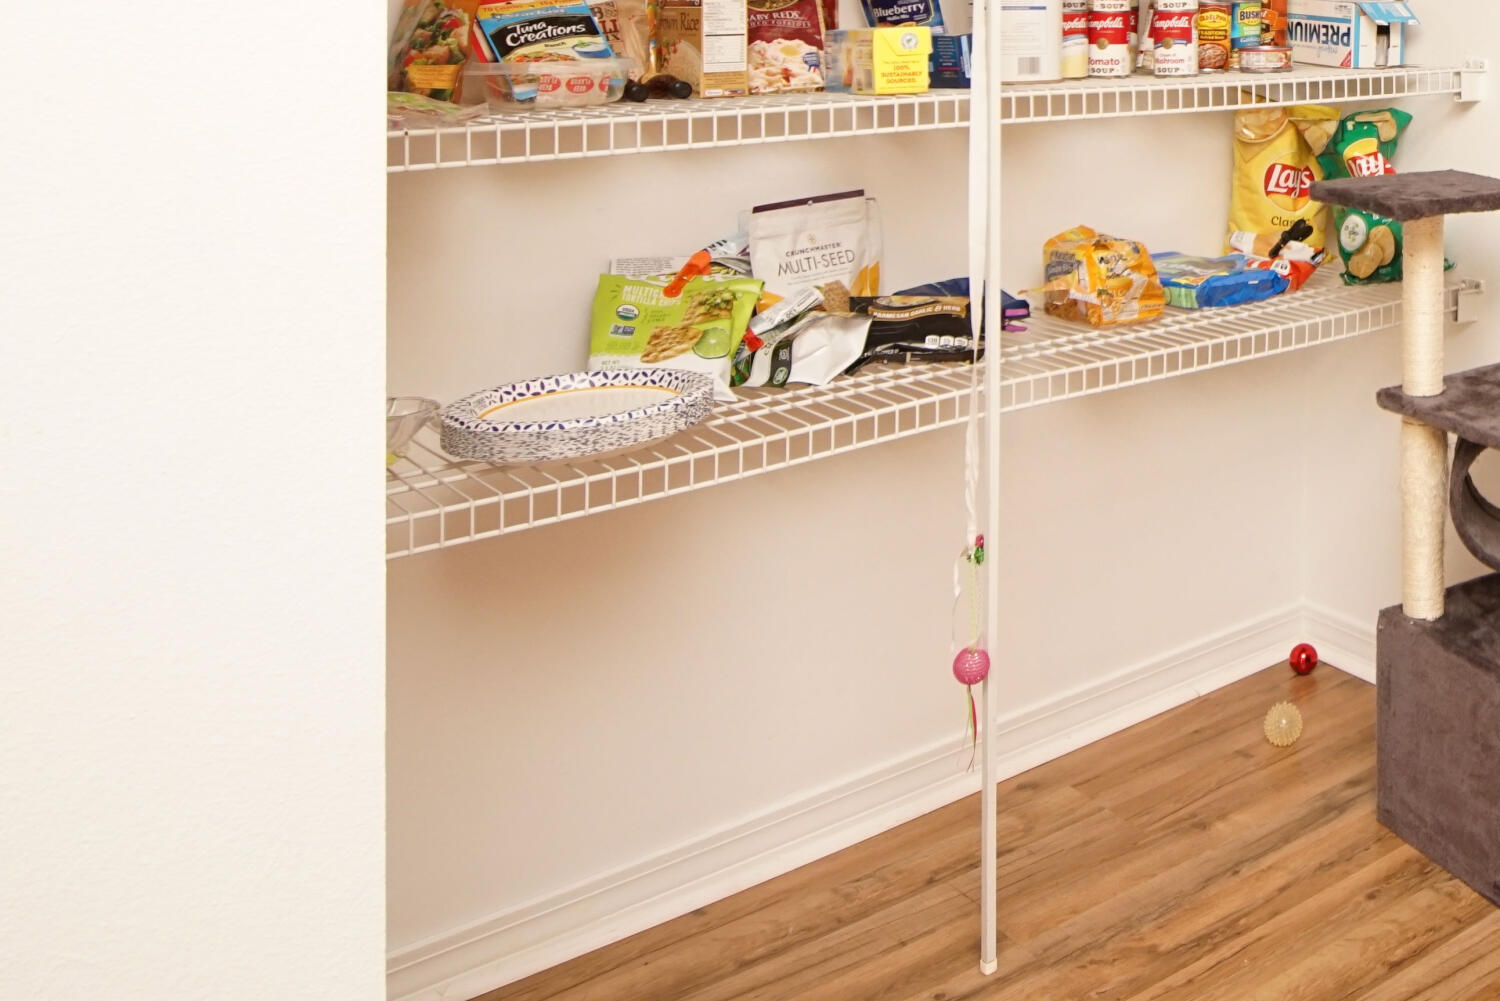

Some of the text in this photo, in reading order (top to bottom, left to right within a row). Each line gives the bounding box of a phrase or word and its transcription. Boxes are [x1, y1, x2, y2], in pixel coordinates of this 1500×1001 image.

[873, 3, 926, 18] Blueberry
[505, 24, 586, 47] Creations
[507, 21, 547, 35] Tuna
[1266, 164, 1311, 198] Lay's
[785, 242, 841, 257] CRUNCHMASTER
[778, 249, 855, 277] MULTI-SEED
